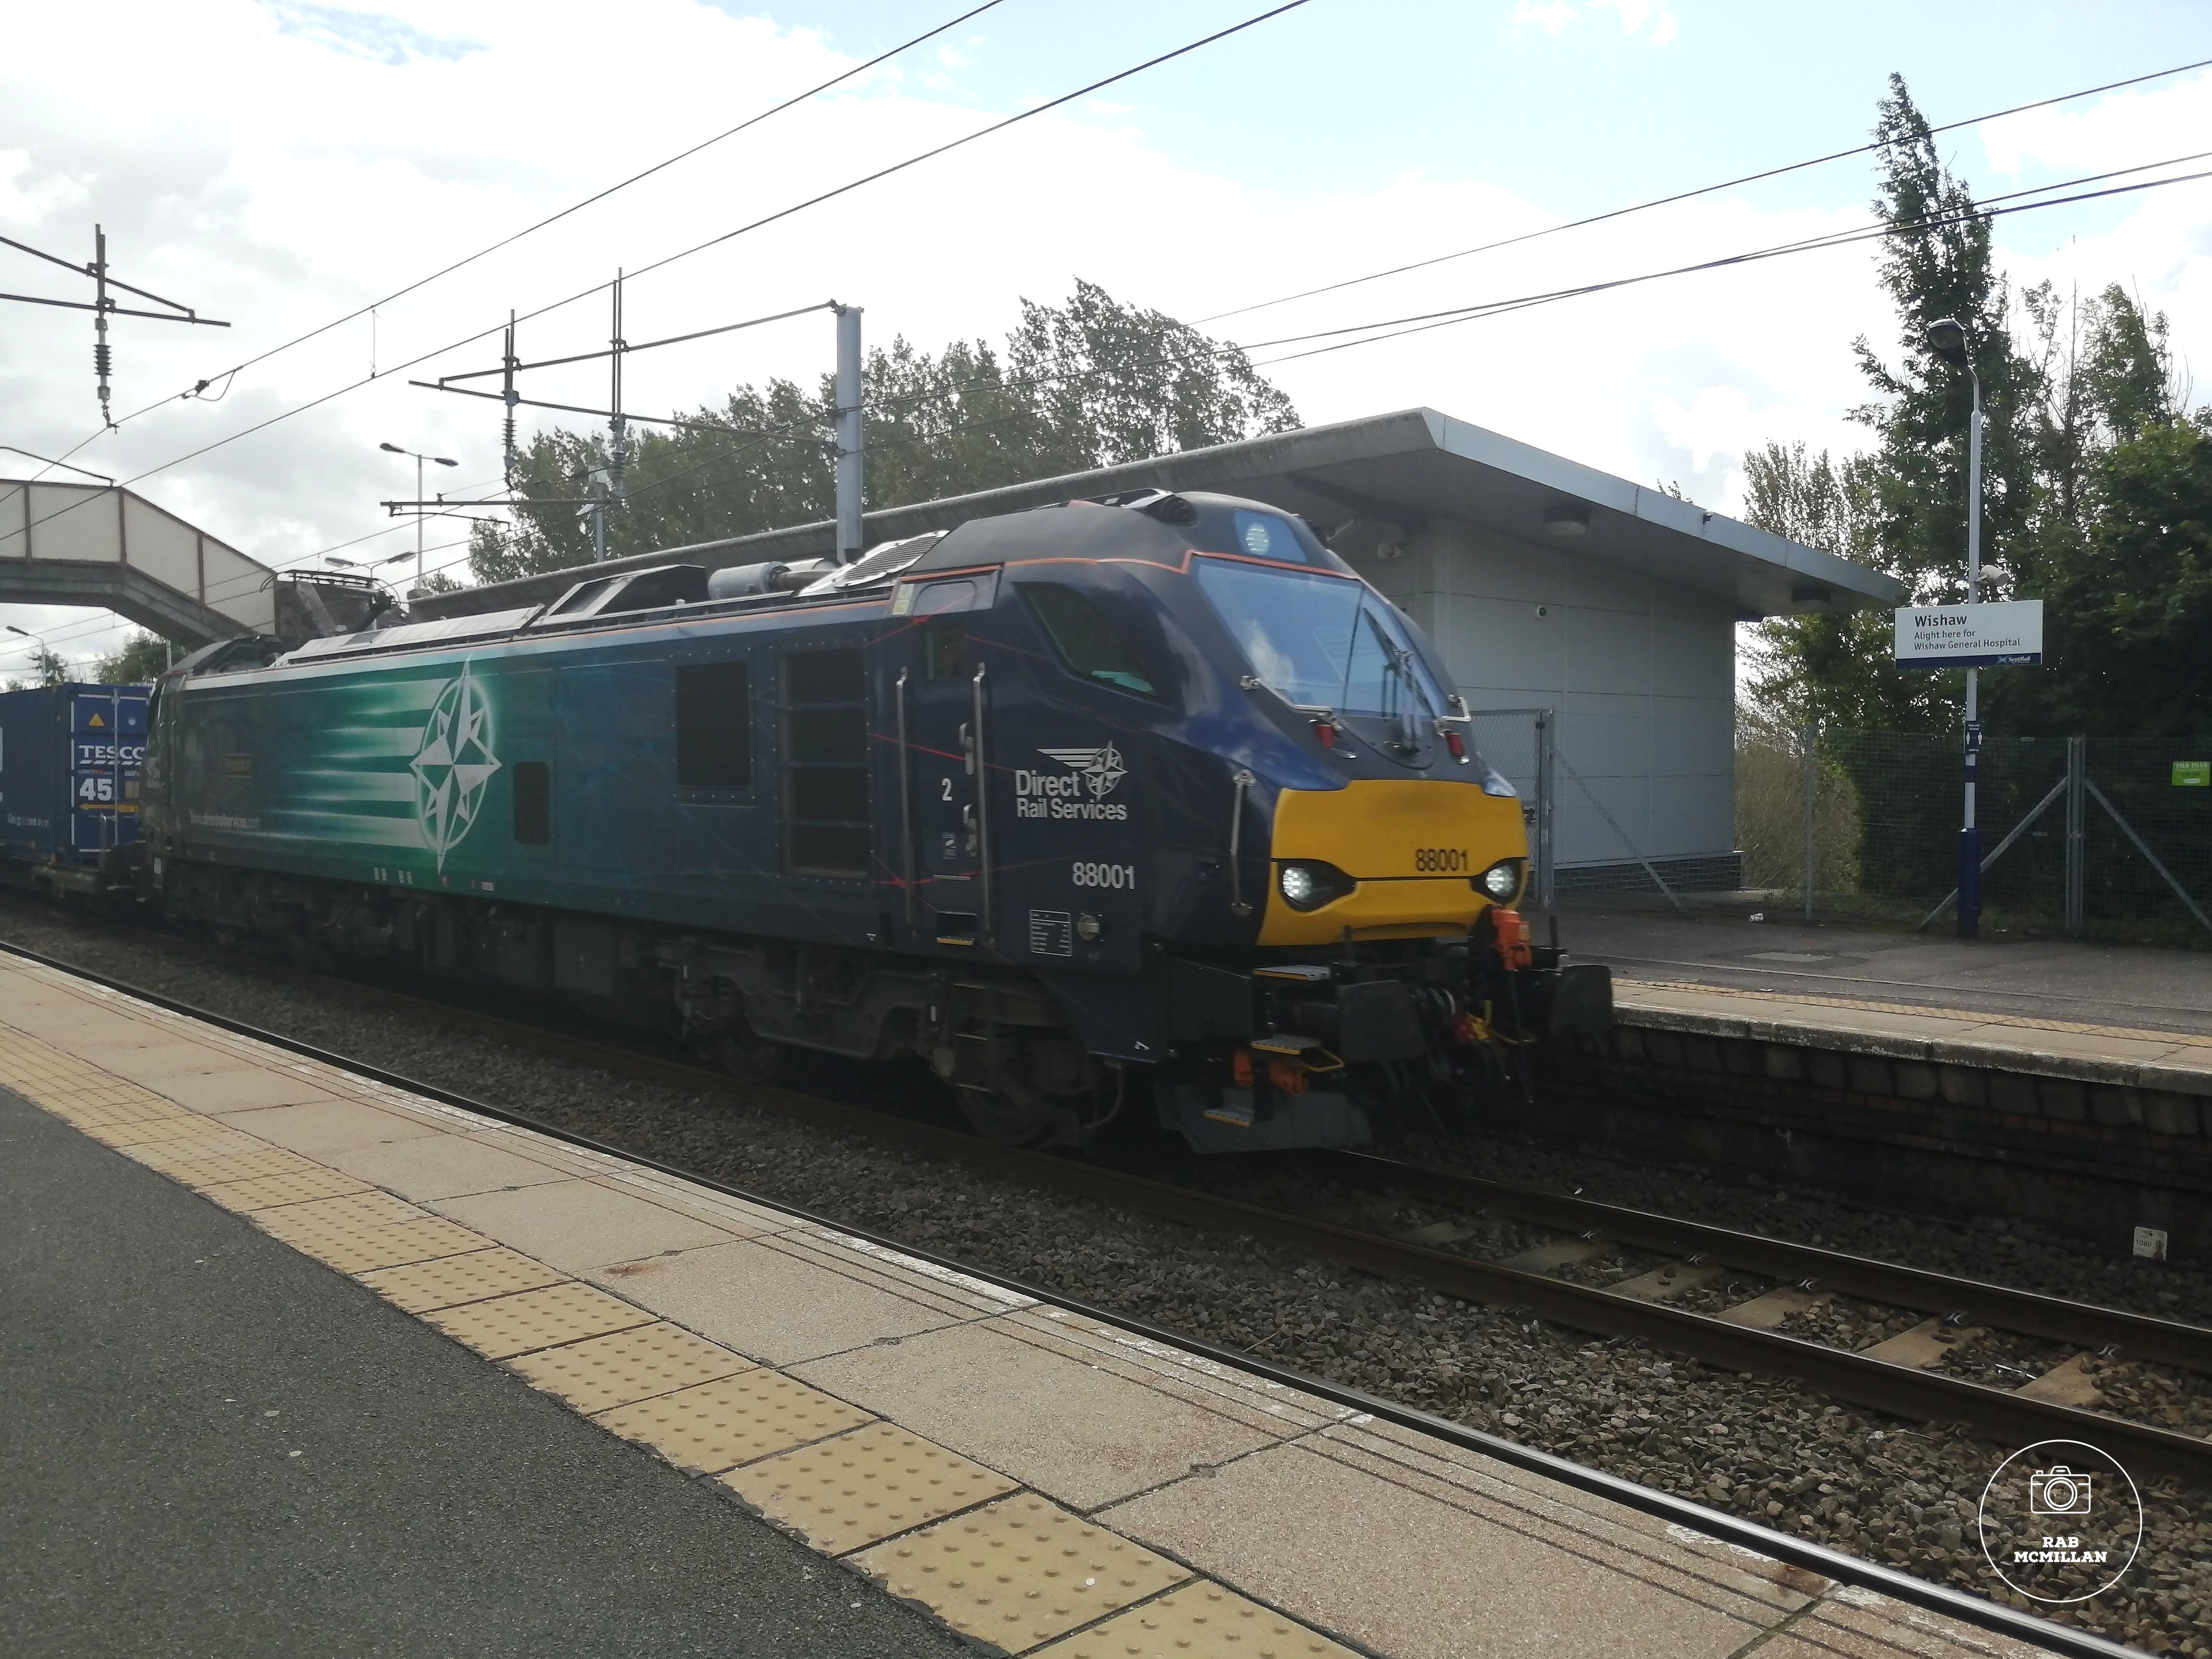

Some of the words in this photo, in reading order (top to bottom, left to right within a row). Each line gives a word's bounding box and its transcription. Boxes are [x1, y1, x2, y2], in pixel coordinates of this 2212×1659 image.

[1915, 614, 1967, 627] Wishaw
[1914, 641, 1946, 650] Wishaw
[1948, 639, 1981, 649] General
[1984, 637, 2021, 648] Hospital
[1915, 630, 1940, 641] Alight
[1942, 630, 1961, 638] here
[1963, 629, 1975, 637] for
[79, 778, 113, 801] 45
[941, 778, 953, 801] 2
[1015, 770, 1081, 797] Direct
[1017, 798, 1047, 818] Rail
[1050, 798, 1128, 820] Services
[1414, 849, 1469, 872] 88001
[1072, 862, 1135, 889] 88001
